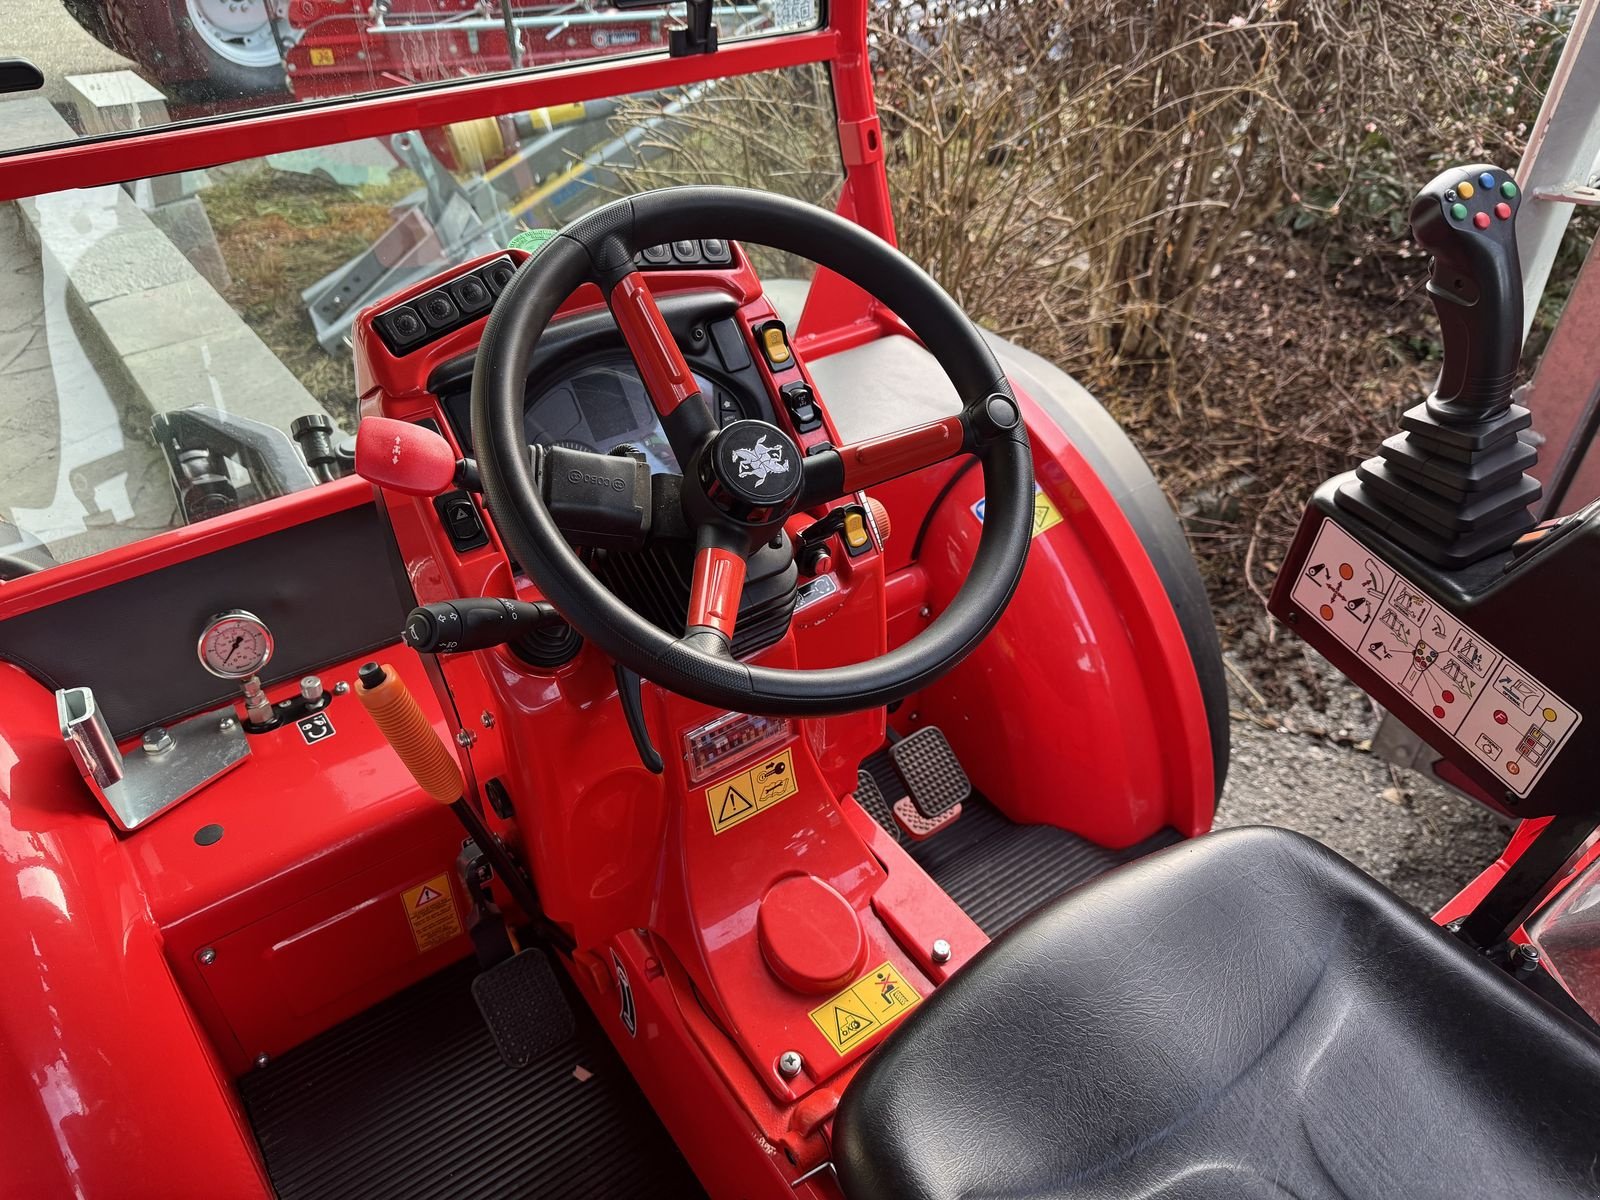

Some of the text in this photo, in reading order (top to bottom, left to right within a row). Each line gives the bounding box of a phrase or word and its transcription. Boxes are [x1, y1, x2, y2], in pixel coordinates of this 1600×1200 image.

[584, 474, 610, 487] COBO
[1457, 654, 1474, 669] OPTIONAL
[1502, 690, 1521, 706] OPTIONAL
[1481, 735, 1500, 751] OPTIONAL
